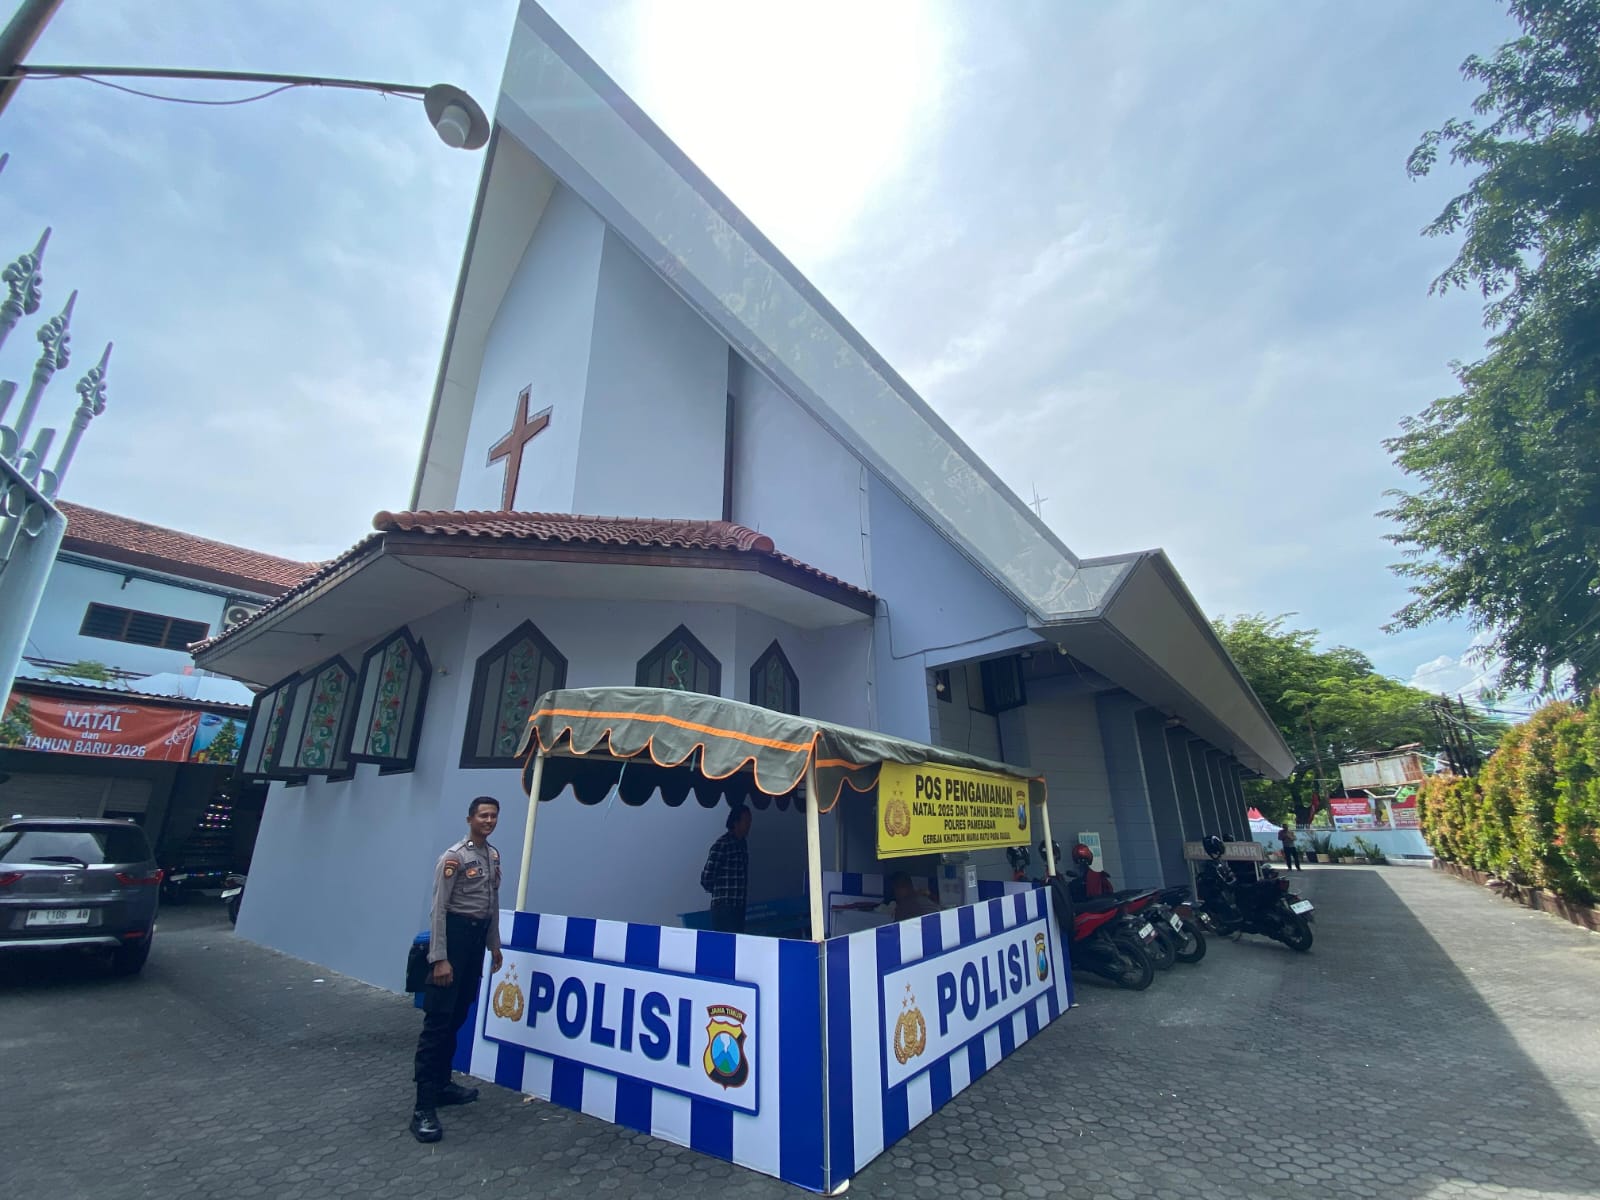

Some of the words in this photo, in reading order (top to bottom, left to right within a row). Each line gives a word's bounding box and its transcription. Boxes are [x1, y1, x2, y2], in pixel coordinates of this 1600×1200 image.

[64, 710, 122, 732] NATAL
[81, 732, 99, 740] dan
[24, 735, 70, 752] TAHUN
[74, 740, 112, 755] BARU
[113, 744, 147, 757] 2026
[915, 775, 942, 801] POS
[946, 779, 1013, 806] PENGAMANAN
[912, 802, 936, 816] NATAL
[938, 804, 953, 816] 2025
[956, 805, 968, 817] DAN
[970, 805, 988, 817] TAHUN
[990, 807, 1003, 818] BARU
[944, 819, 965, 830] POLRES
[967, 820, 996, 830] PAMEKASAN
[923, 834, 942, 844] GEREJA
[1228, 846, 1257, 857] ARKIR
[937, 940, 1032, 1037] POLISI
[526, 970, 692, 1068] POLISI
[726, 1008, 742, 1020] TIMUR
